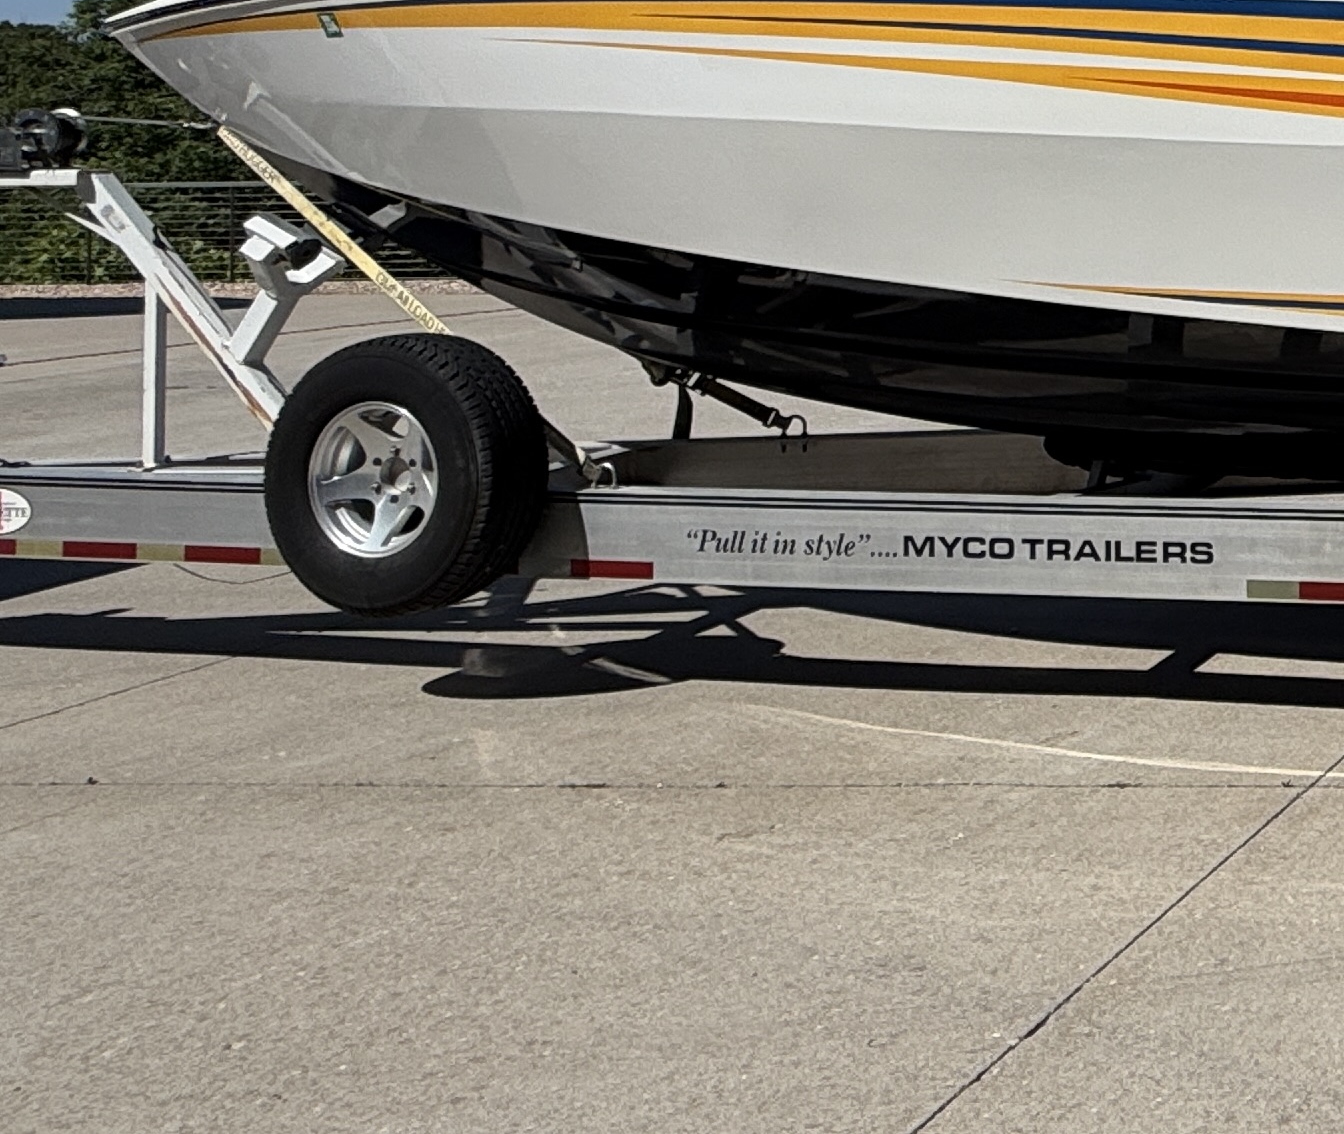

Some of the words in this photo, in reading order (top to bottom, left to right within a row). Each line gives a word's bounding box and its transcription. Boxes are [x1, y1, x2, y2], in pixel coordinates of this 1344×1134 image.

[751, 530, 769, 554] it
[773, 531, 796, 555] in
[903, 535, 1015, 559] MYCO
[1021, 538, 1215, 565] TRAILERS
